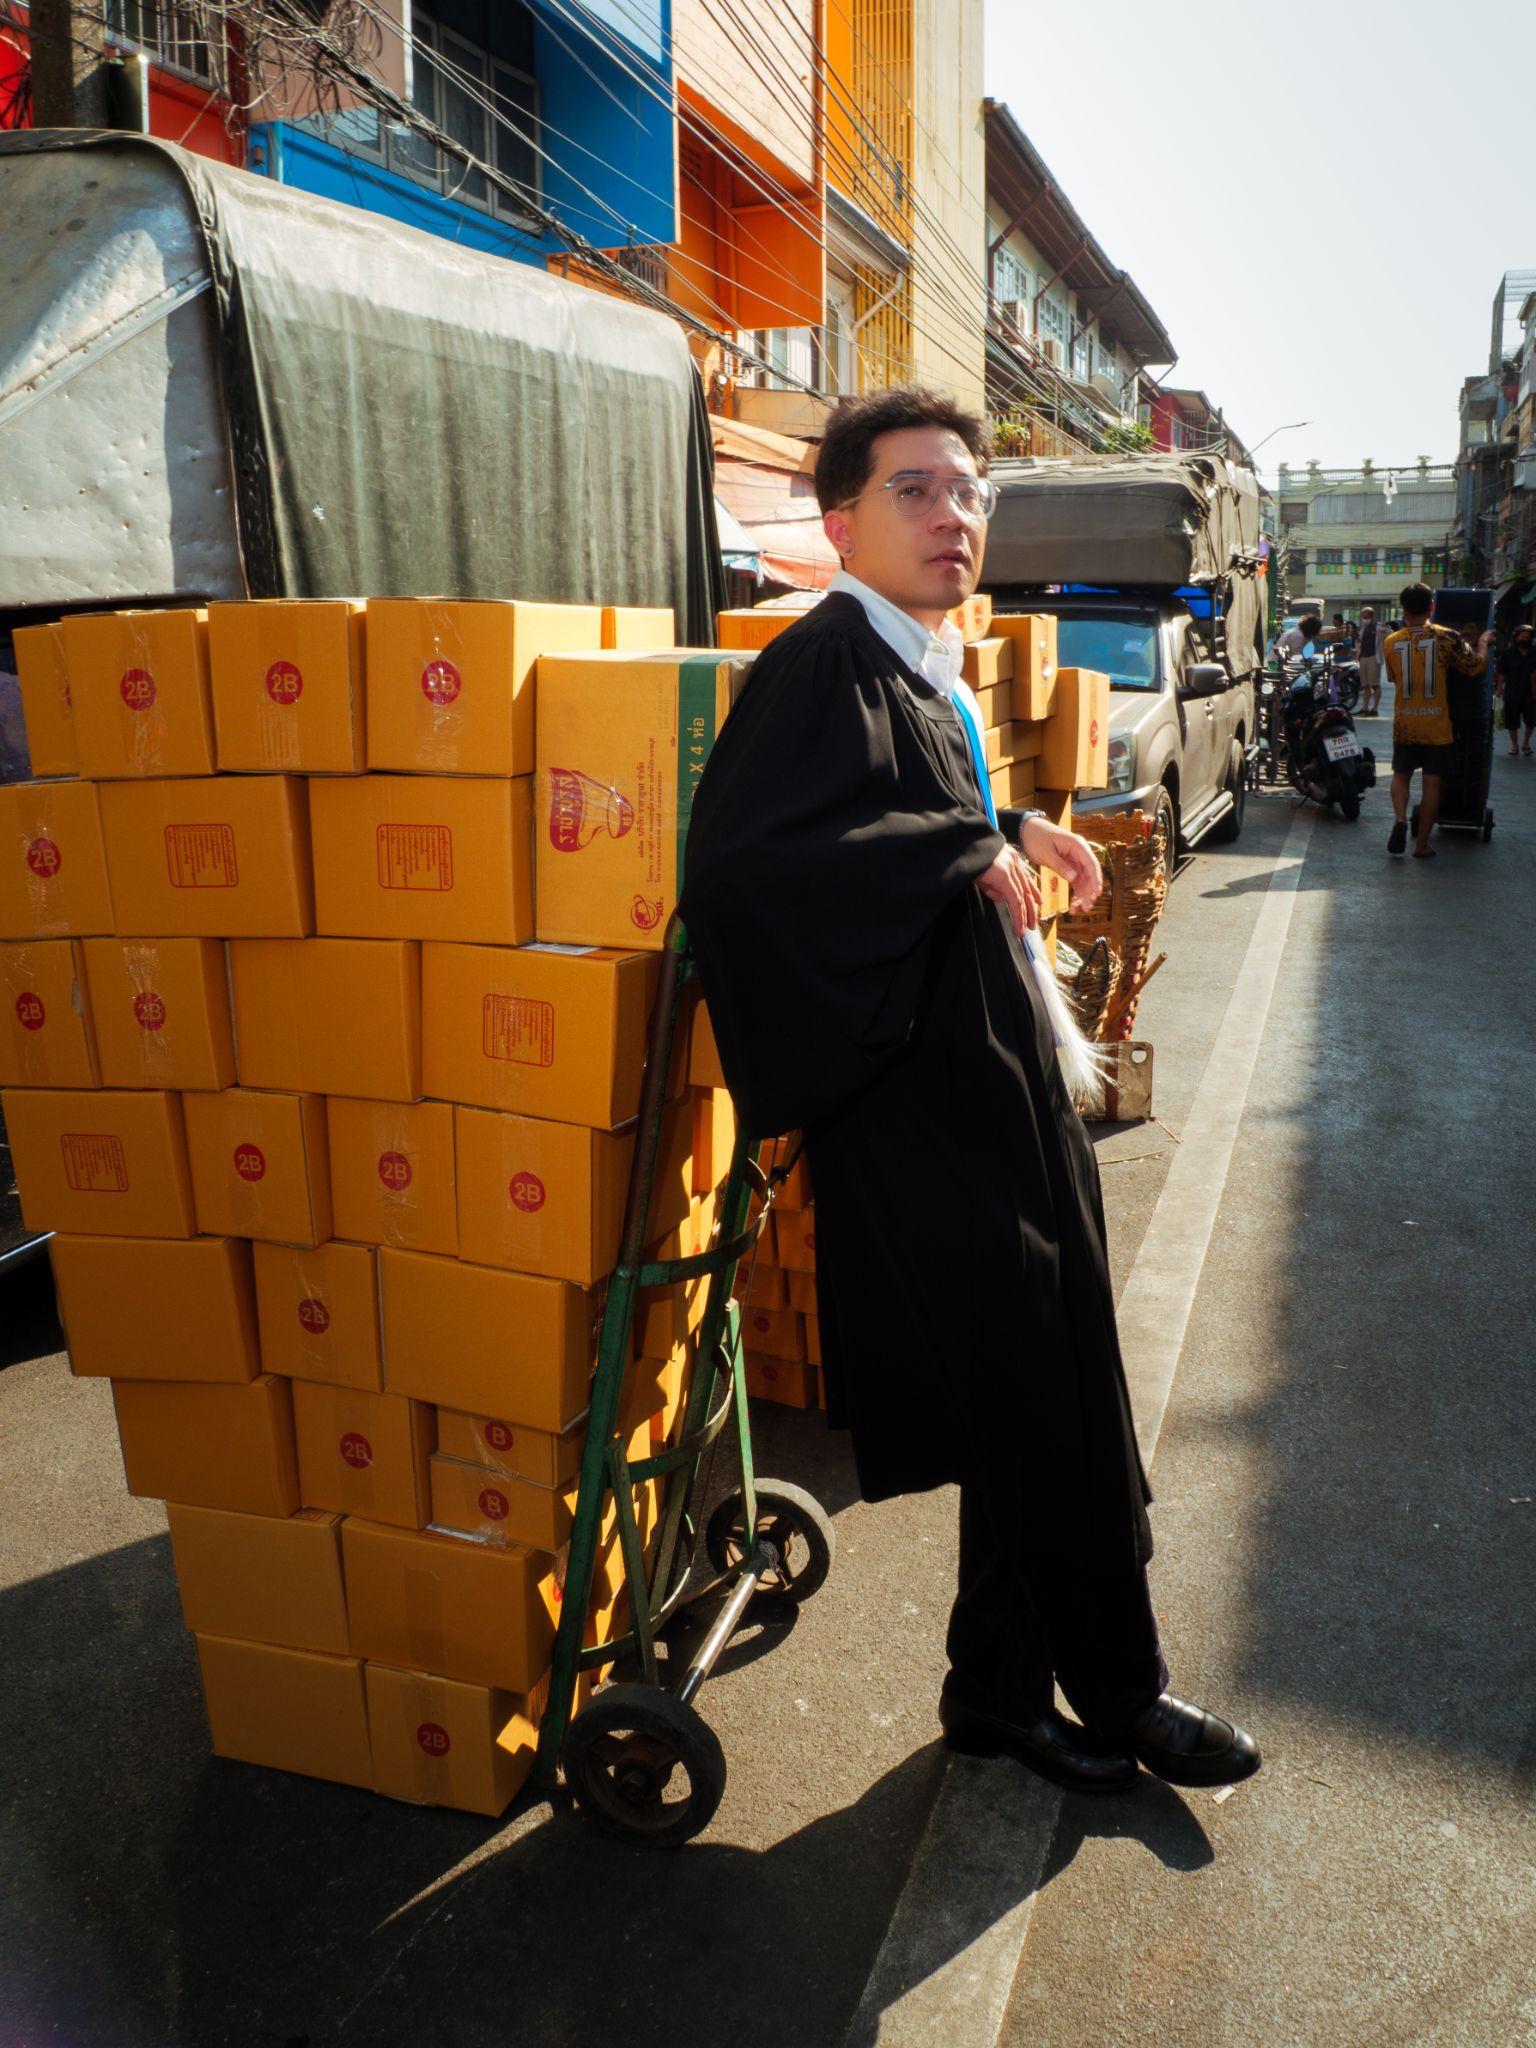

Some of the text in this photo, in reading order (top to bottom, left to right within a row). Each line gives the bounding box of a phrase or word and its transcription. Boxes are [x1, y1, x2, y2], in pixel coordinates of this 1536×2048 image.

[1393, 638, 1437, 699] 11
[125, 681, 151, 700] 2B
[272, 673, 298, 692] 2B
[427, 673, 456, 693] 2B
[690, 746, 704, 756] 4
[31, 848, 57, 868] 2B
[20, 1003, 43, 1020] 2B
[139, 1003, 161, 1020] 2B
[238, 1153, 262, 1172] 2B
[383, 1161, 408, 1180] 2B
[514, 1182, 541, 1203] 2B
[302, 1307, 325, 1324] 2B
[492, 1426, 506, 1445] B
[344, 1441, 367, 1460] 2B
[488, 1495, 502, 1512] B
[421, 1730, 446, 1749] 2B
